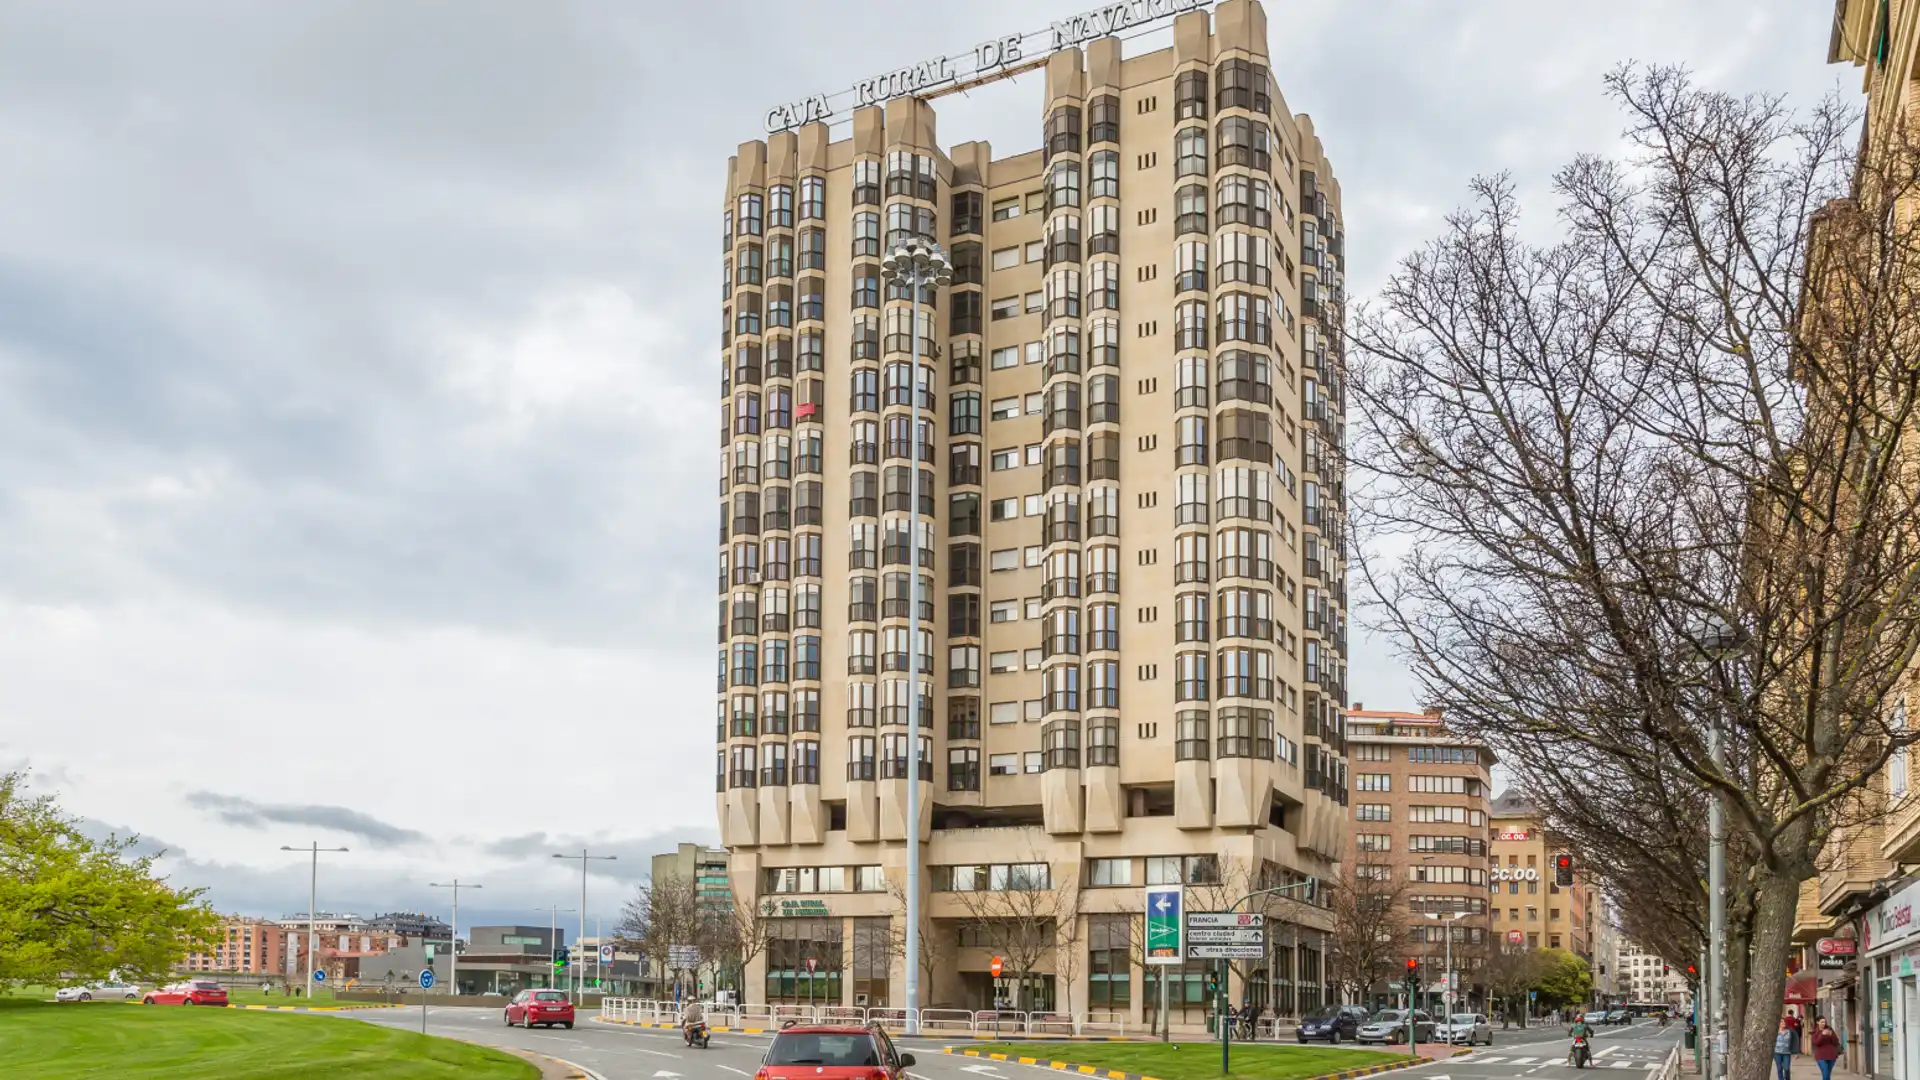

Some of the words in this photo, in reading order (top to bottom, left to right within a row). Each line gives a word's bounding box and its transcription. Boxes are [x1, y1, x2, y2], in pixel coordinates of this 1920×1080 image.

[763, 92, 833, 133] CAJA
[852, 55, 955, 109] RURAL
[975, 32, 1022, 72] DE
[1050, 0, 1214, 49] NAVAR
[1189, 916, 1219, 924] FRANCIA
